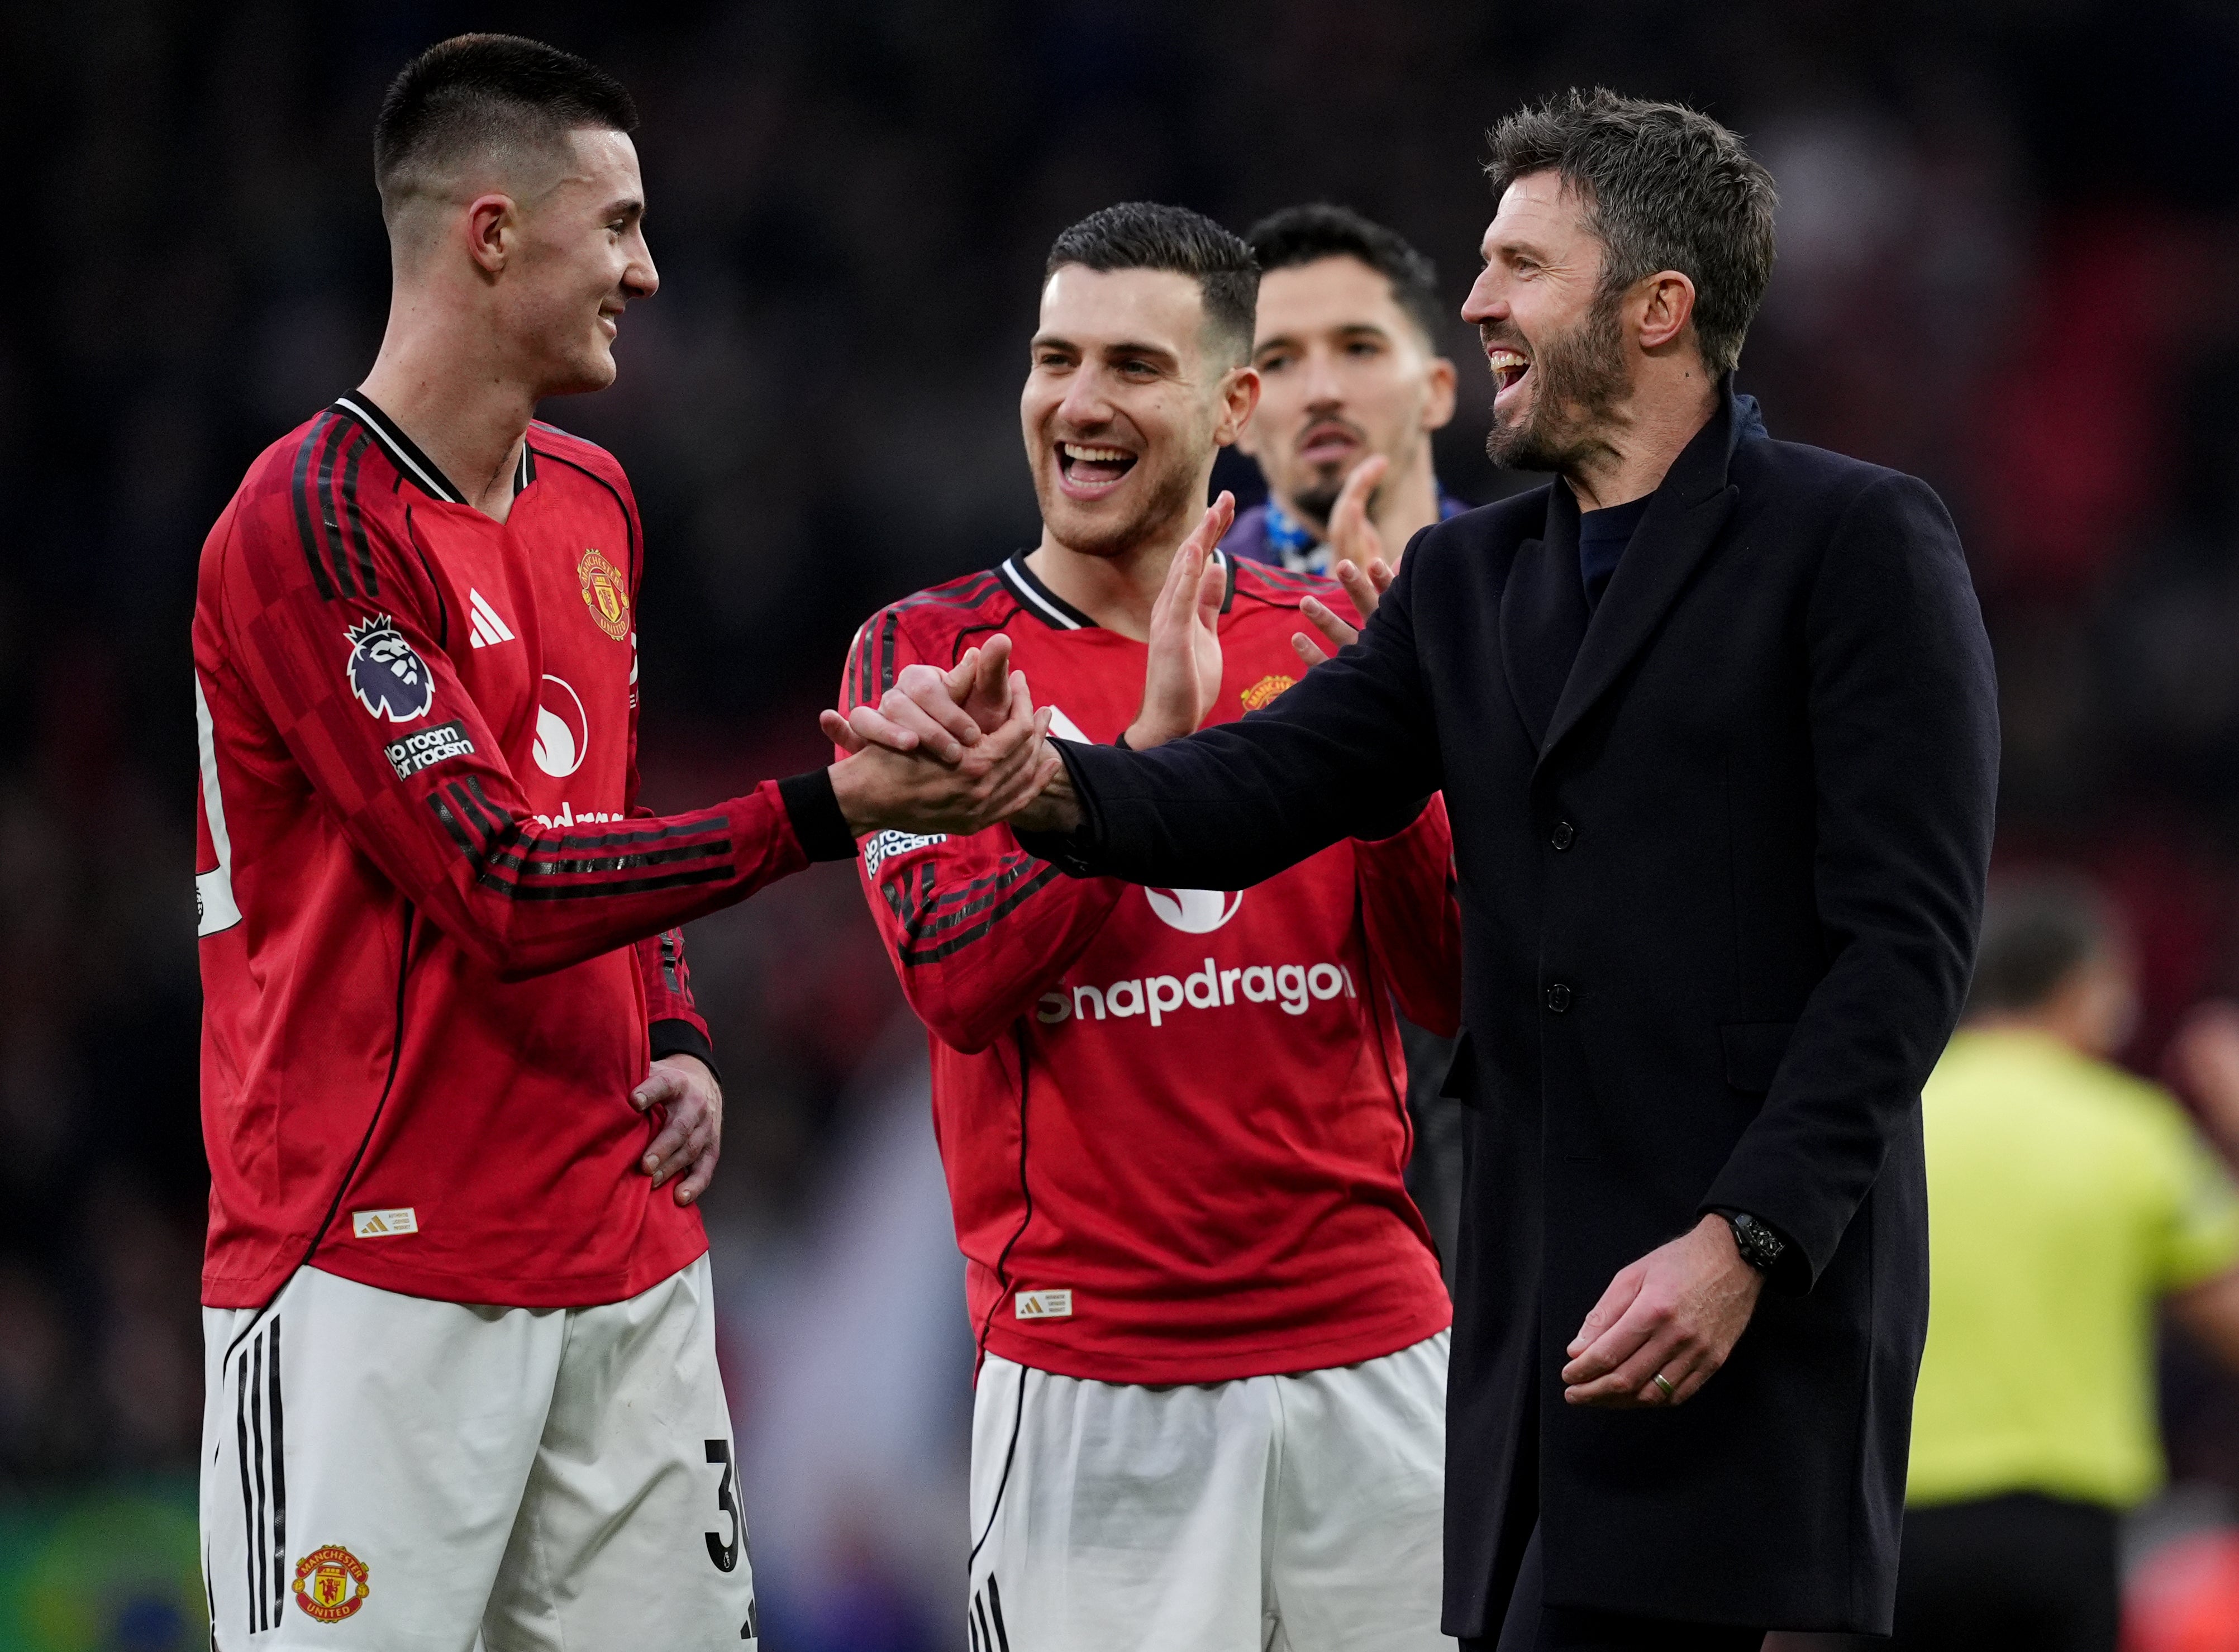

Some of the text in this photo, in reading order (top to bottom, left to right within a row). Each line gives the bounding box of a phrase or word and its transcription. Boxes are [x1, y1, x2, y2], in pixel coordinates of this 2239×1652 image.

[582, 556, 620, 585] MANCHESTER
[600, 620, 626, 634] UNITED
[405, 727, 459, 754] room
[412, 739, 475, 770] racism
[880, 833, 947, 860] racism
[301, 1550, 363, 1578] MANCHESTER
[307, 1603, 350, 1617] UNITED
